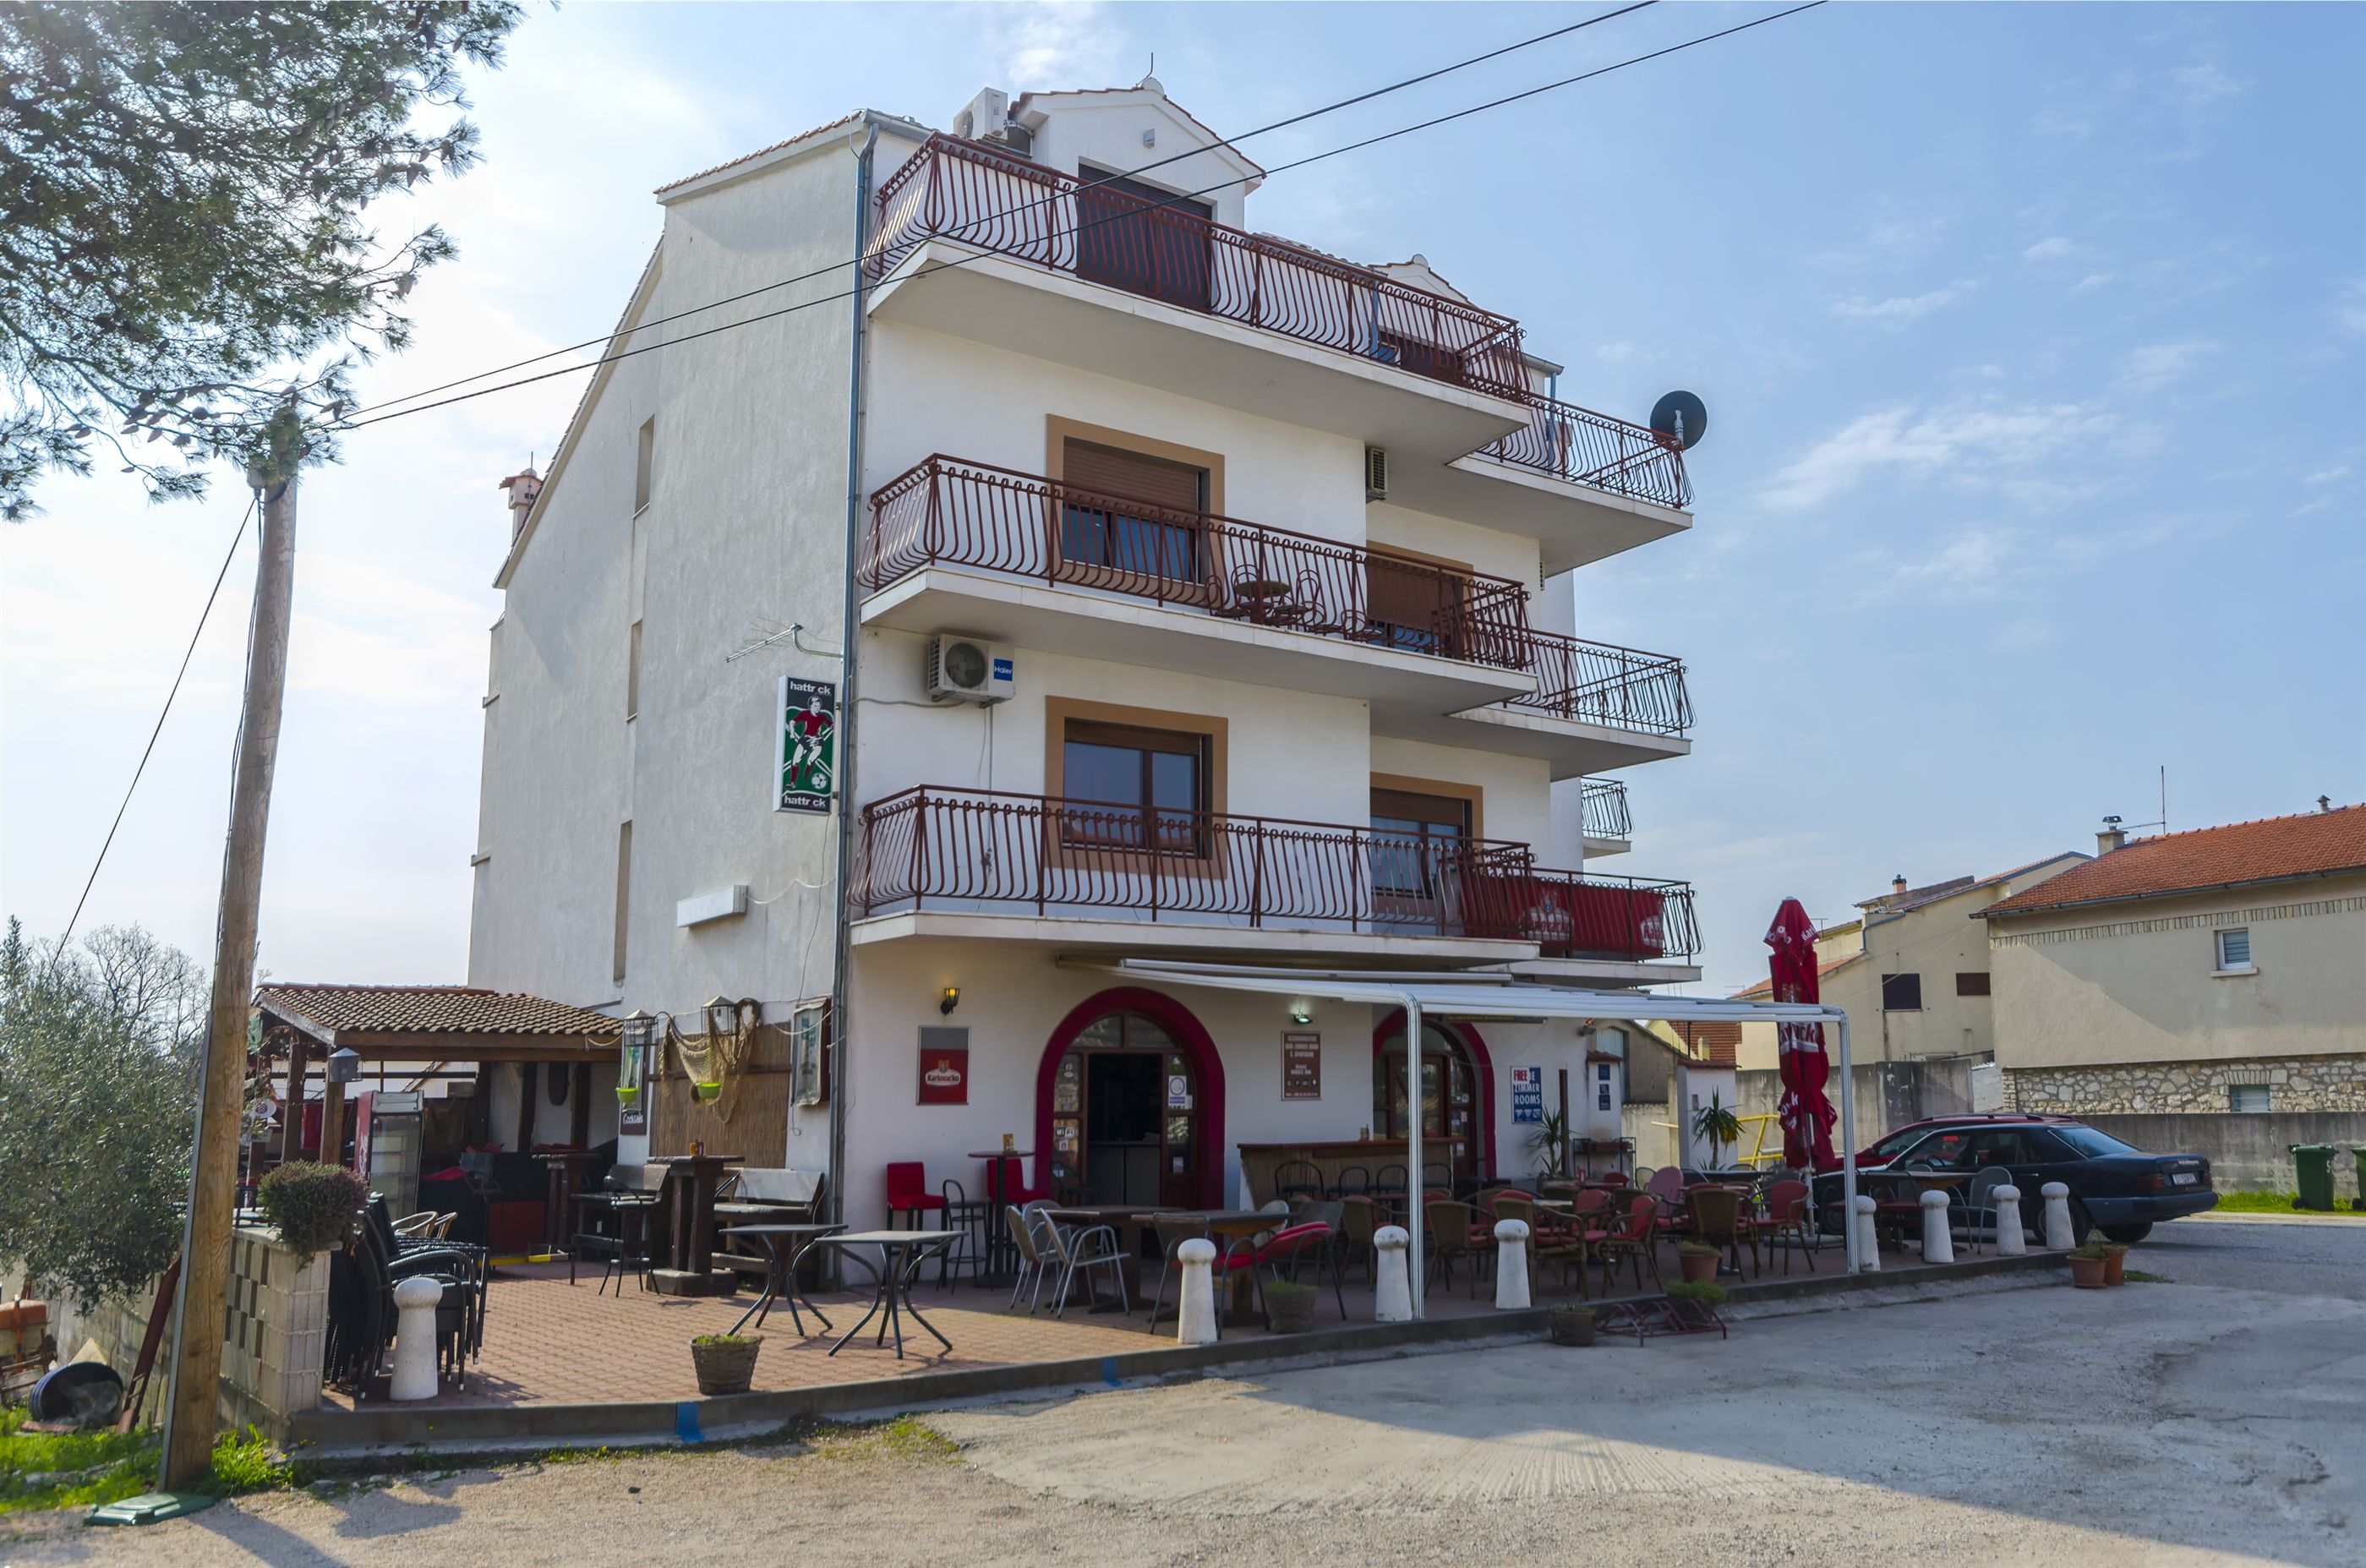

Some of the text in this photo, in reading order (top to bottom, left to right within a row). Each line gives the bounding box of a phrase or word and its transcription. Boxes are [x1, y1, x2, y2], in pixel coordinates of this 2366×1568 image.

[994, 666, 1013, 675] Haier
[1513, 1069, 1527, 1082] FREE
[1514, 1083, 1540, 1093] ZIMMER
[1514, 1095, 1541, 1105] ROOMS
